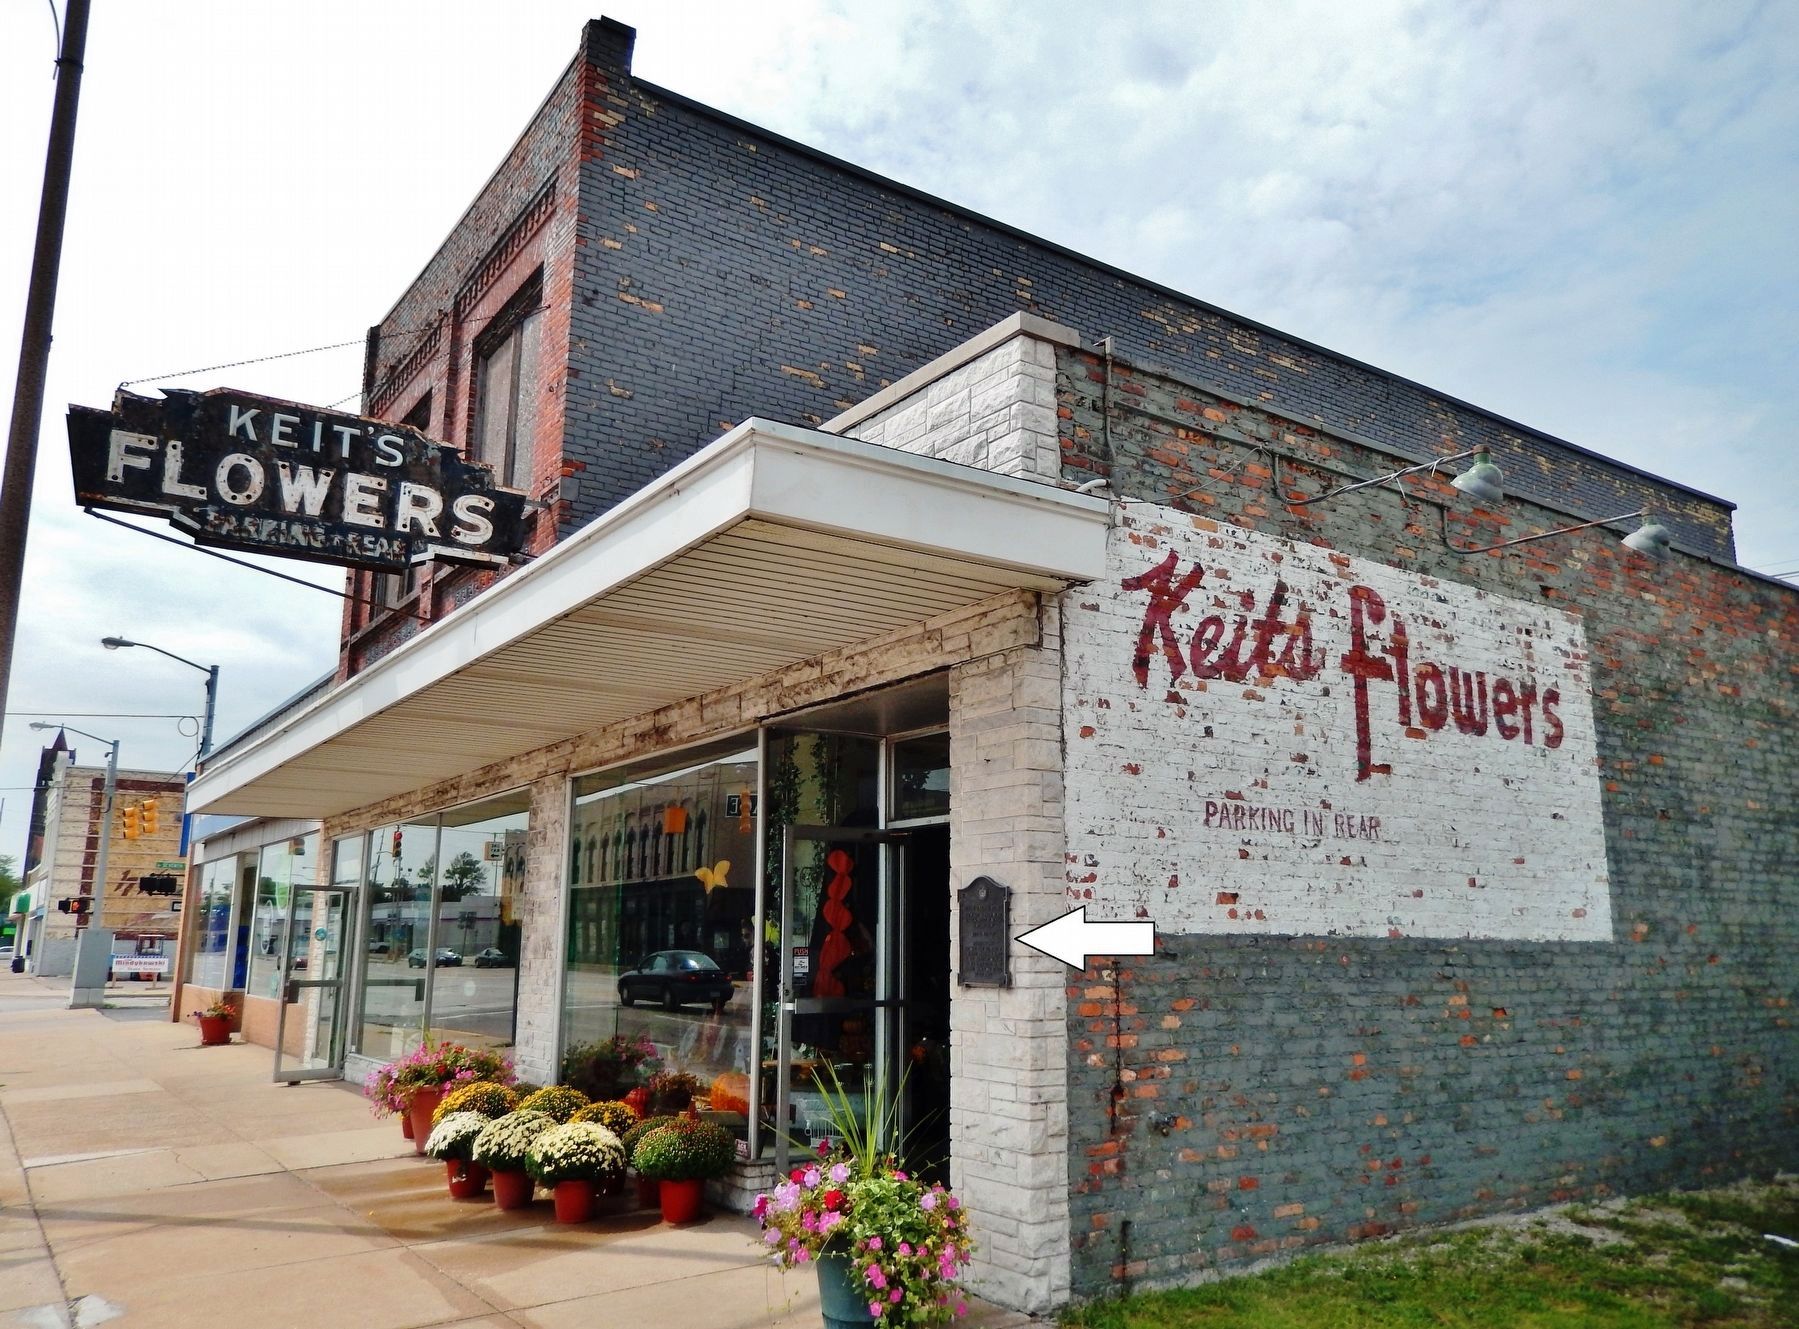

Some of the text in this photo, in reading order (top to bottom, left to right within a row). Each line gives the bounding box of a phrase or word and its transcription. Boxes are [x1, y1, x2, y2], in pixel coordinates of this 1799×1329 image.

[229, 404, 405, 468] KEIT'S
[106, 428, 495, 545] FLOWERS
[1203, 800, 1381, 839] PARKING IN REAR
